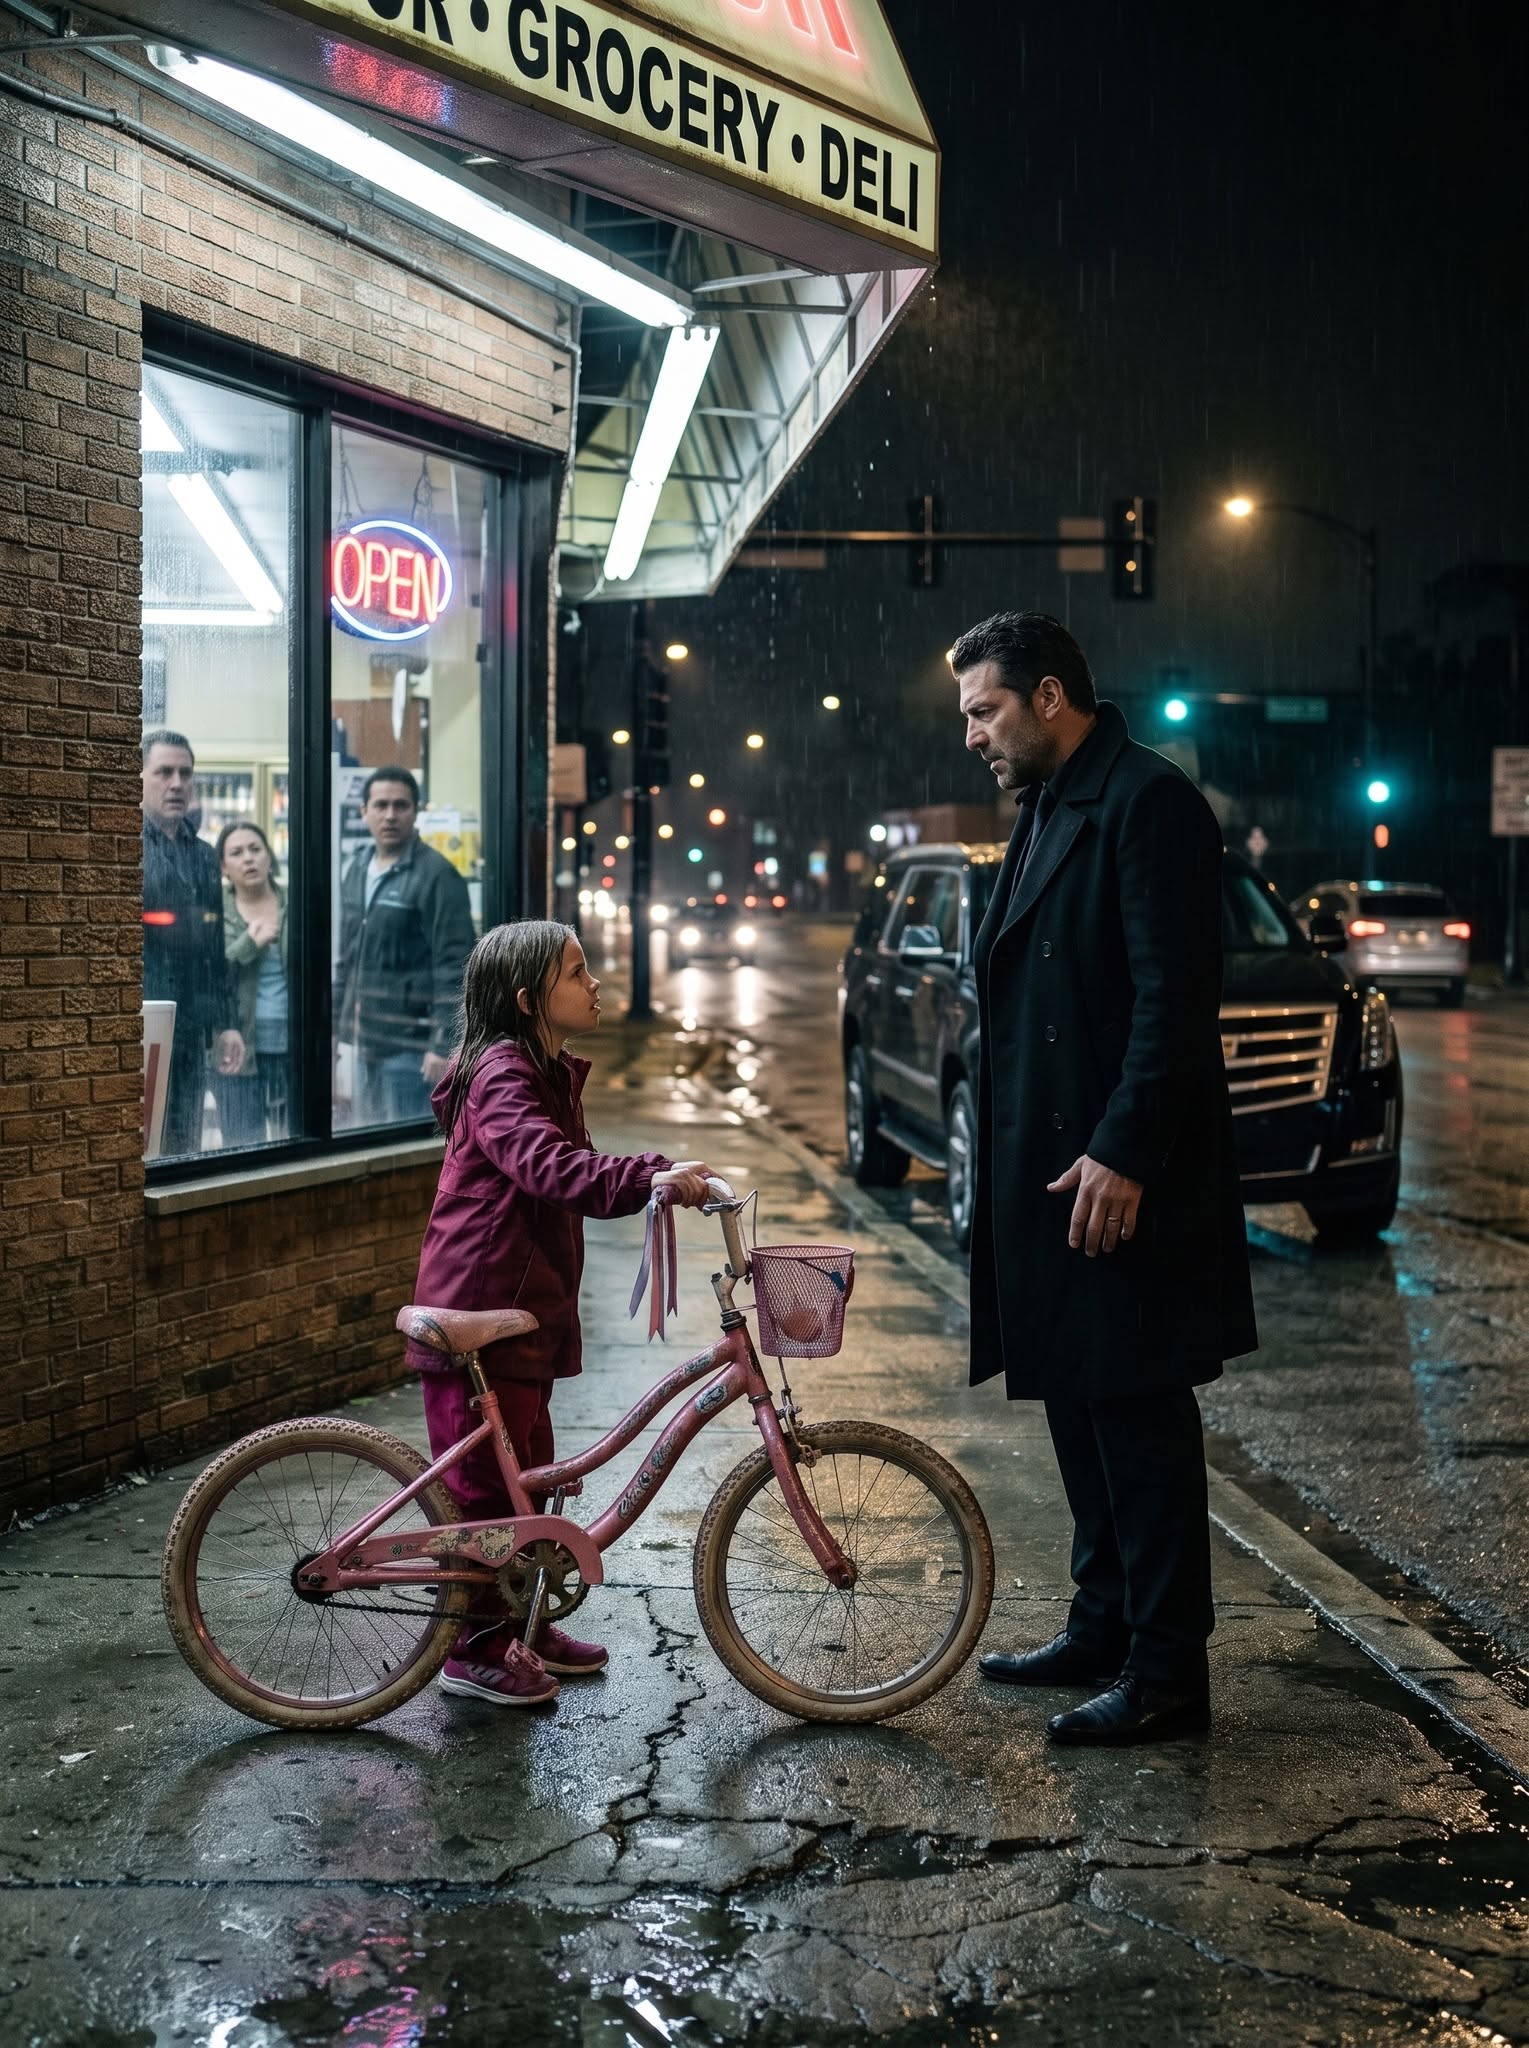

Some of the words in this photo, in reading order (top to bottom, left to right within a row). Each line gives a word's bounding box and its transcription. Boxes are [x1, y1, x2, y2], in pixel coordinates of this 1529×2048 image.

[507, 0, 780, 174] GROCERY
[821, 123, 919, 233] DELI
[333, 536, 441, 624] OPEN
